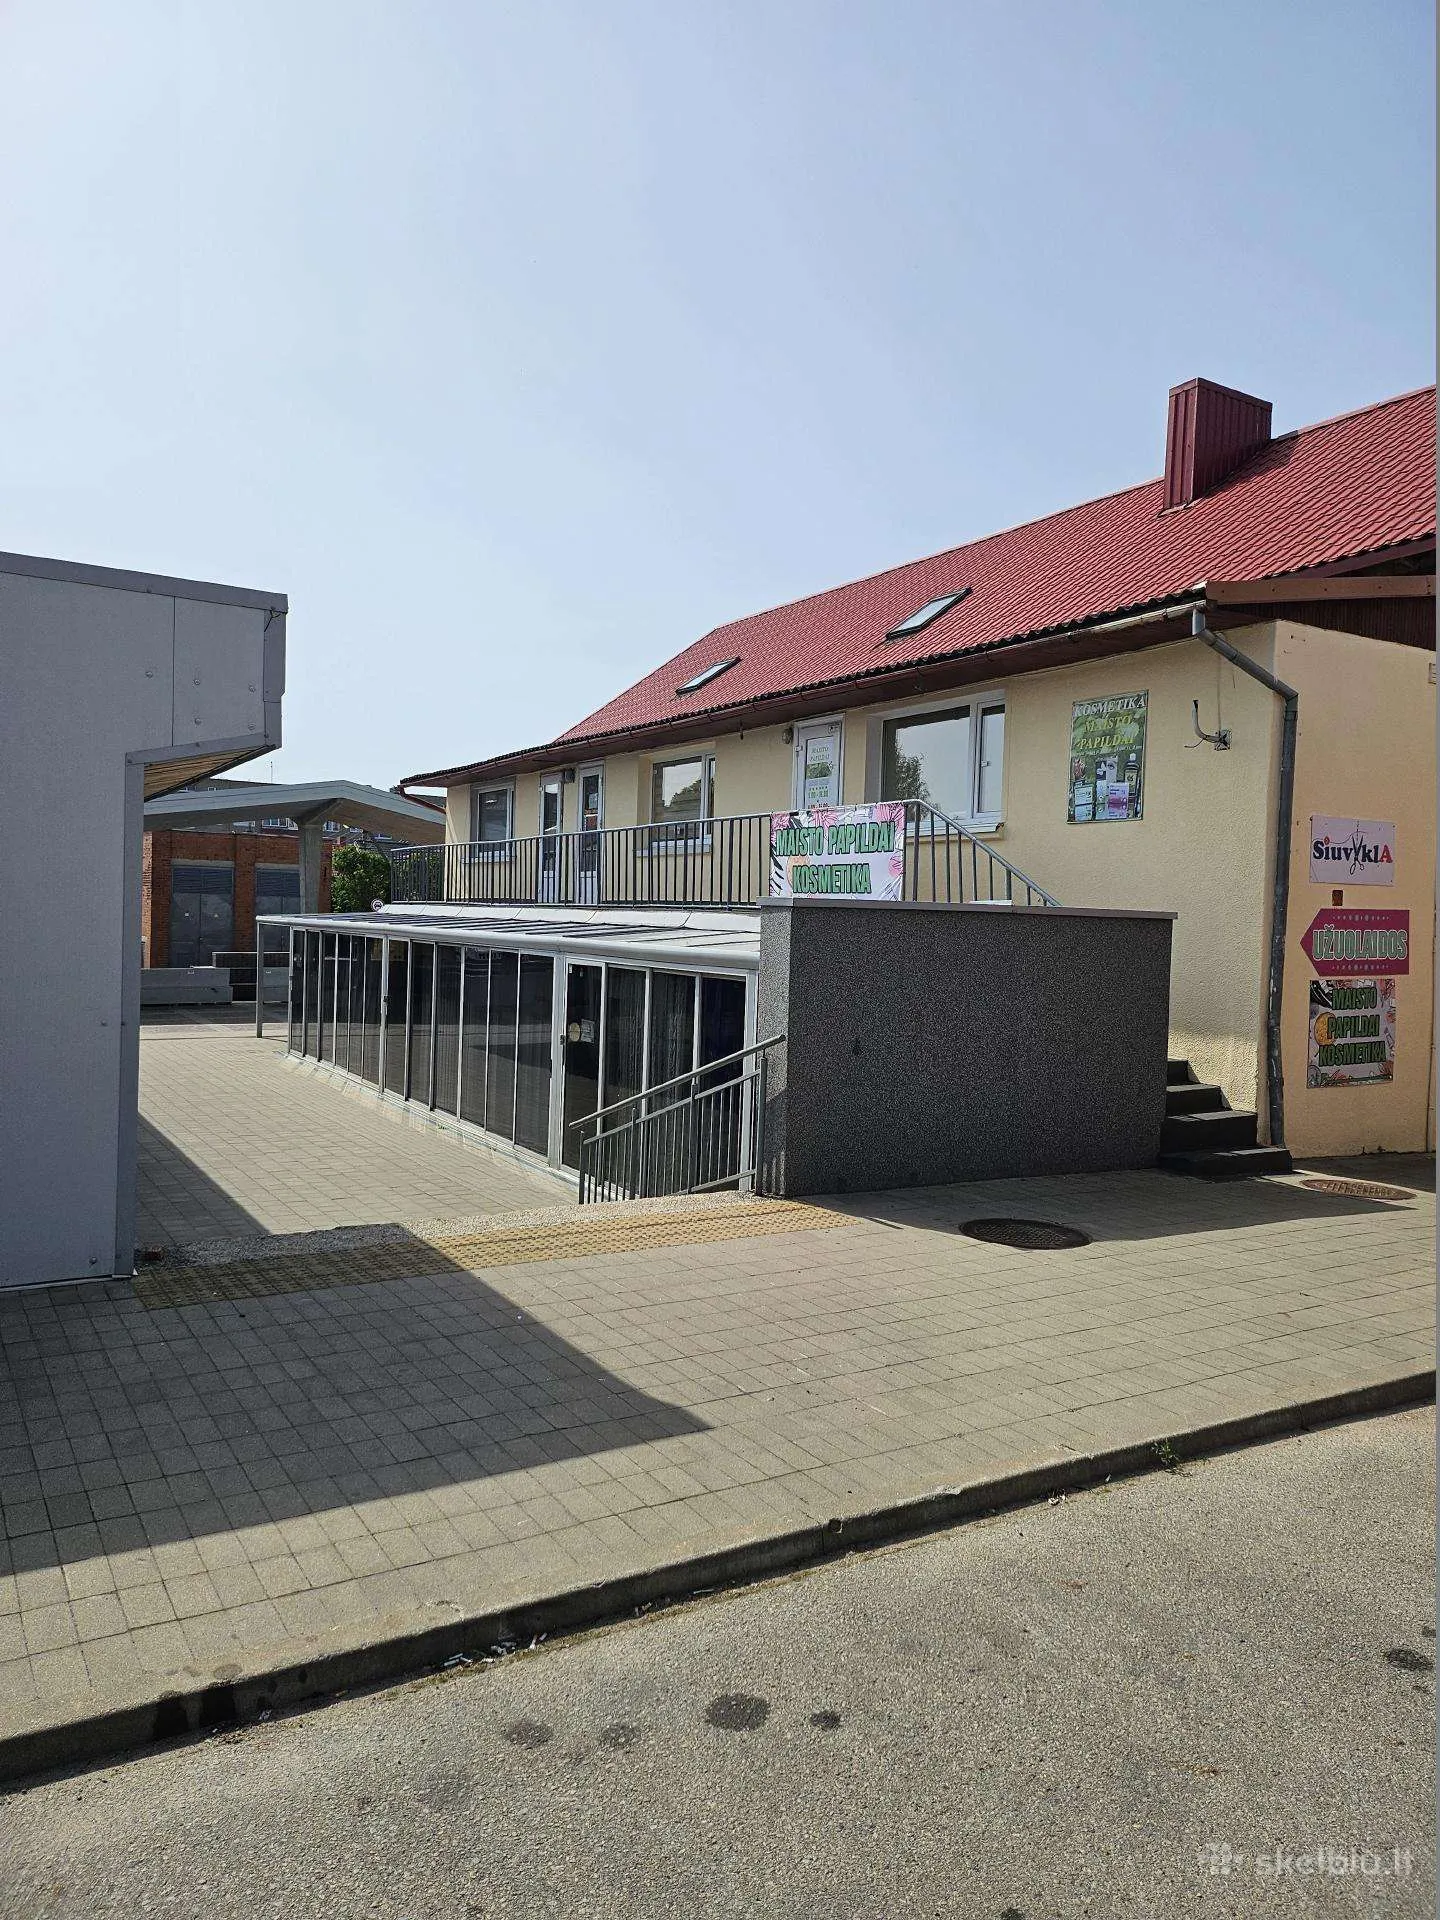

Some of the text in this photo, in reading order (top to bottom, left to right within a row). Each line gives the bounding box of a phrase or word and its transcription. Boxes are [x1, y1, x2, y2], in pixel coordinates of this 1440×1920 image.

[1074, 696, 1146, 717] KOSMETIKA
[1085, 715, 1132, 732] MAISTO
[1078, 734, 1135, 750] PAPILDAI
[776, 821, 896, 856] MAISTO PAPILDAI
[792, 863, 872, 894] KOSMETIKA
[1312, 924, 1408, 960] UŽUOLAIDOS
[1331, 987, 1378, 1010] MAISTO
[1327, 1015, 1381, 1039] PAPILDAI
[1318, 1041, 1387, 1067] KOSMETIKA
